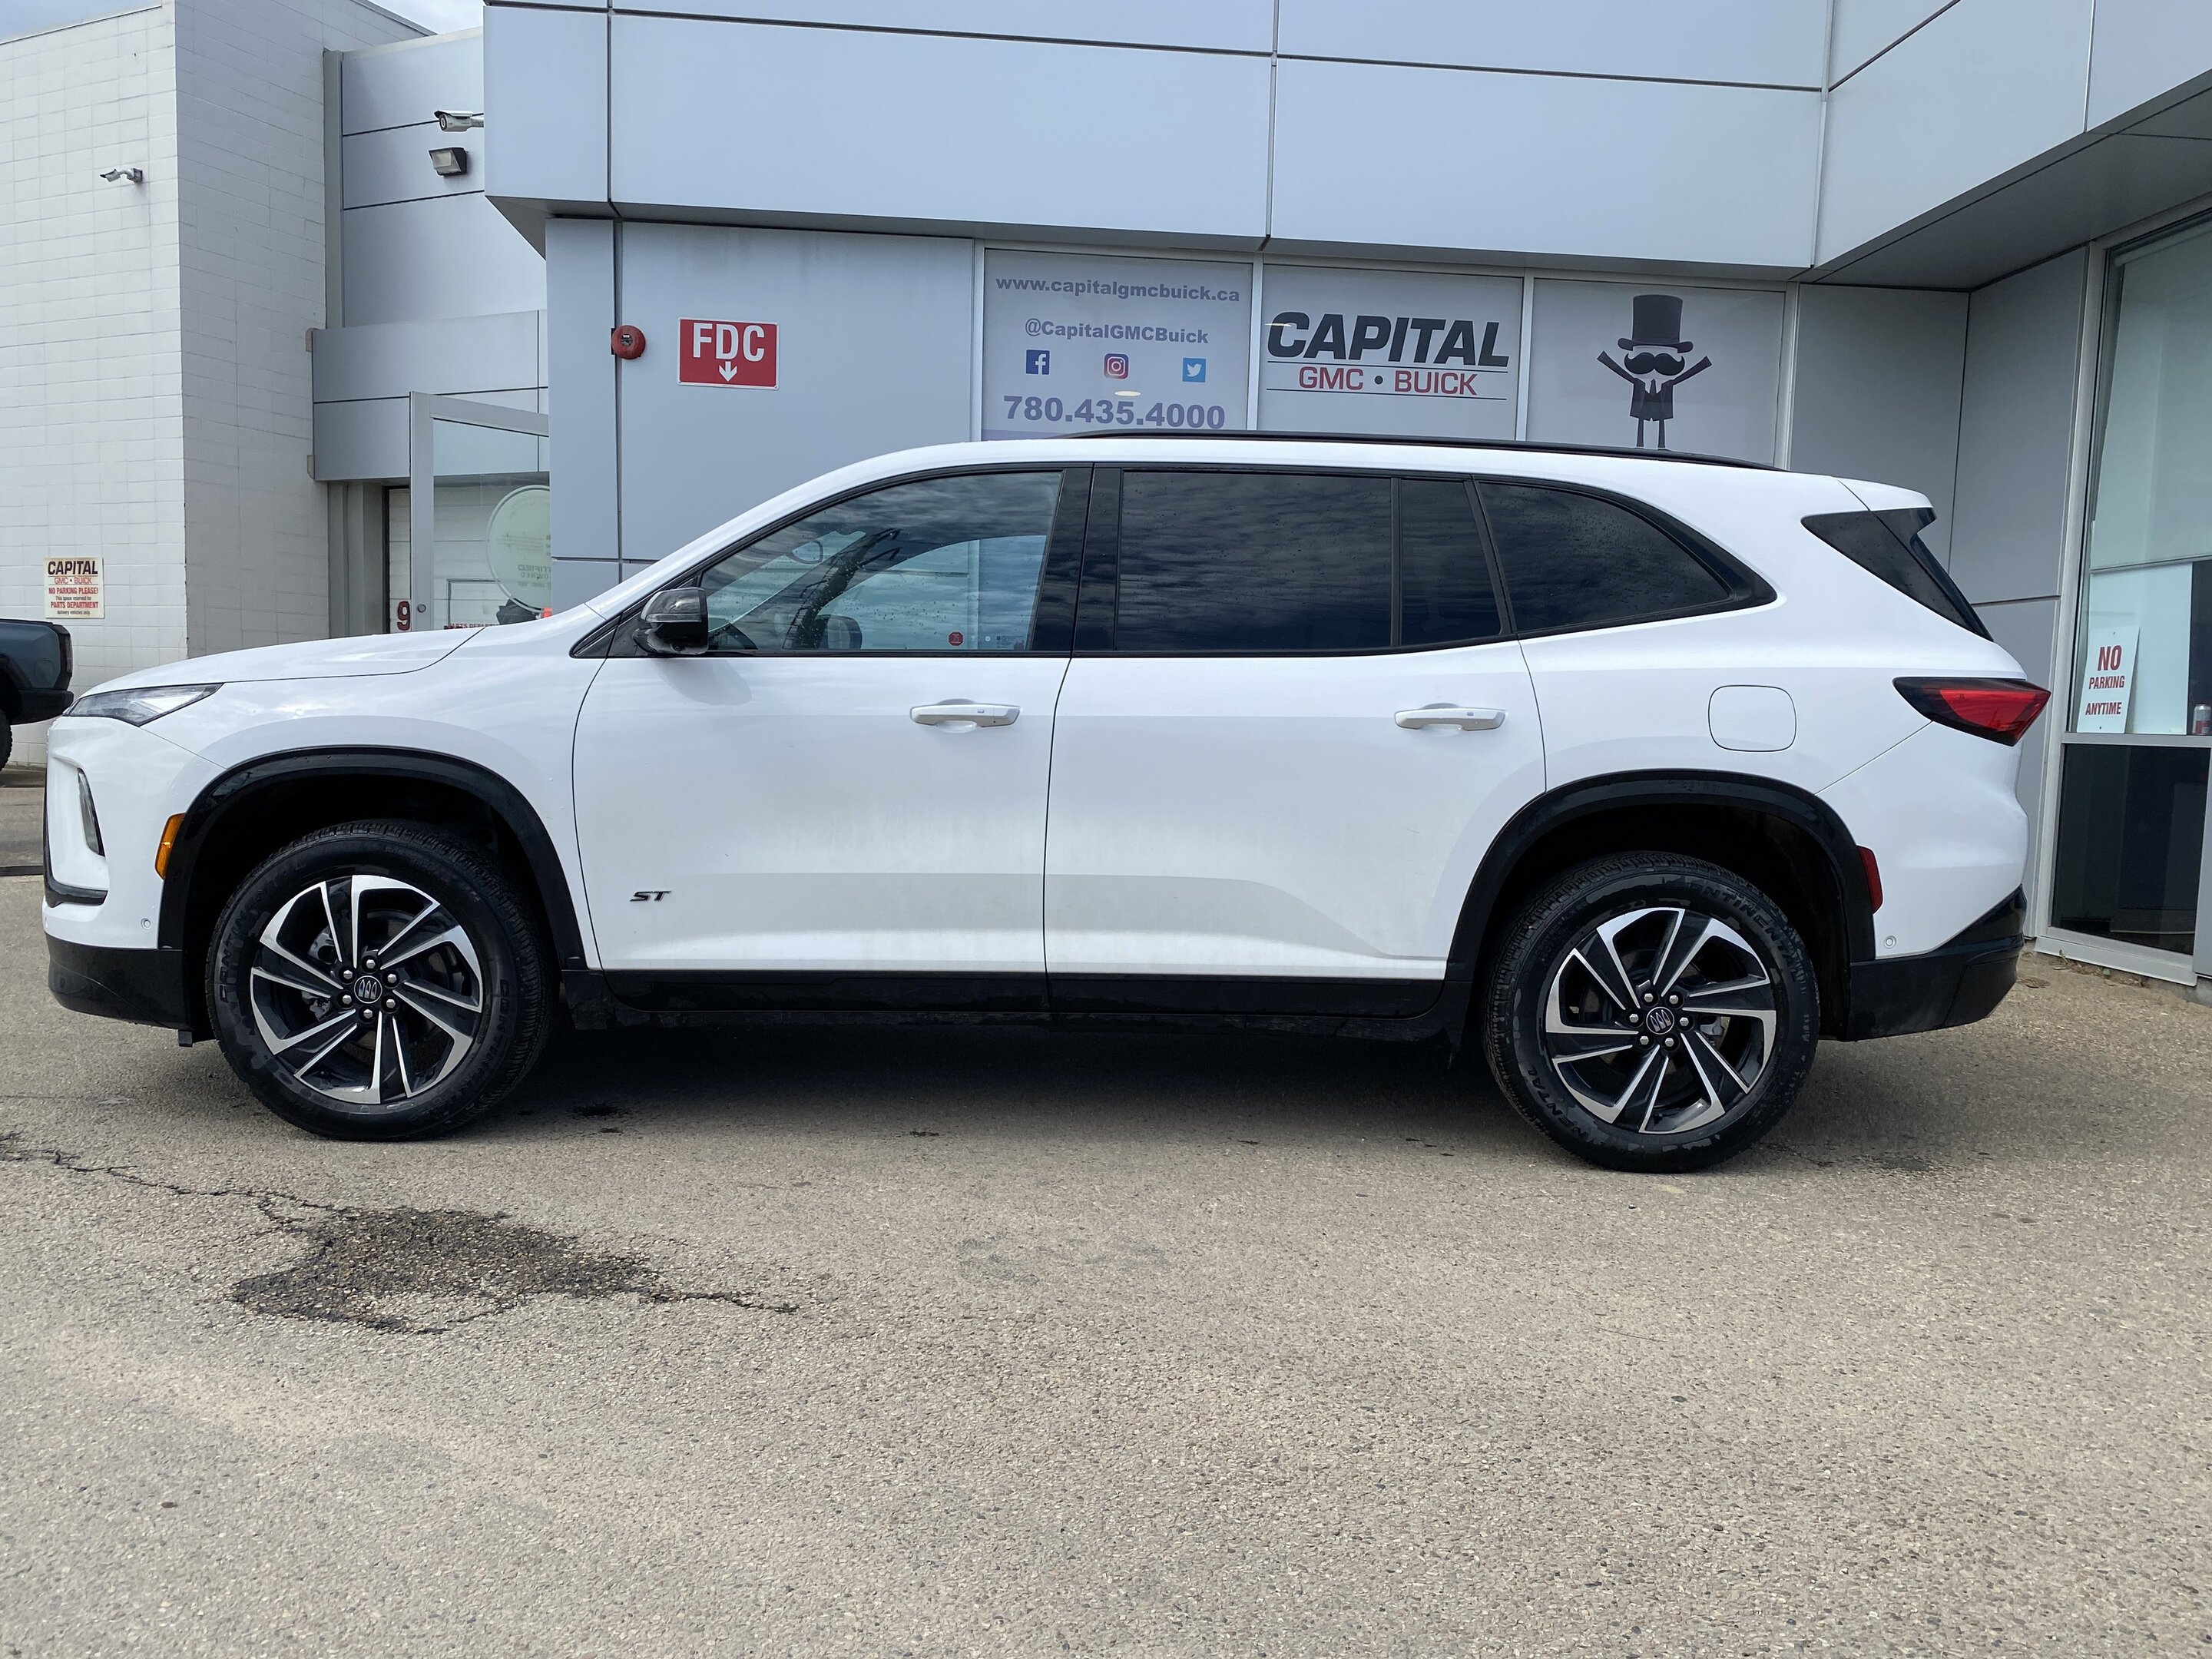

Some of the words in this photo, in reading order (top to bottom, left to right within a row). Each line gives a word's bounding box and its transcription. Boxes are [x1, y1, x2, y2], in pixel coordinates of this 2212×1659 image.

[995, 277, 1240, 302] www.capitalgmcbuick.ca
[693, 322, 765, 362] FDC
[1025, 317, 1209, 344] @CapitalGMCBuick
[1267, 311, 1510, 368] CAPITAL
[1298, 366, 1364, 391] GMC
[1394, 369, 1478, 396] BUICK
[1003, 395, 1226, 429] 780.435.4000
[48, 561, 98, 575] CAPITAL
[396, 601, 411, 631] 9
[2097, 644, 2122, 671] NO
[2088, 675, 2125, 690] PARKING
[2085, 701, 2122, 716] ANYTIME
[629, 890, 672, 902] ST
